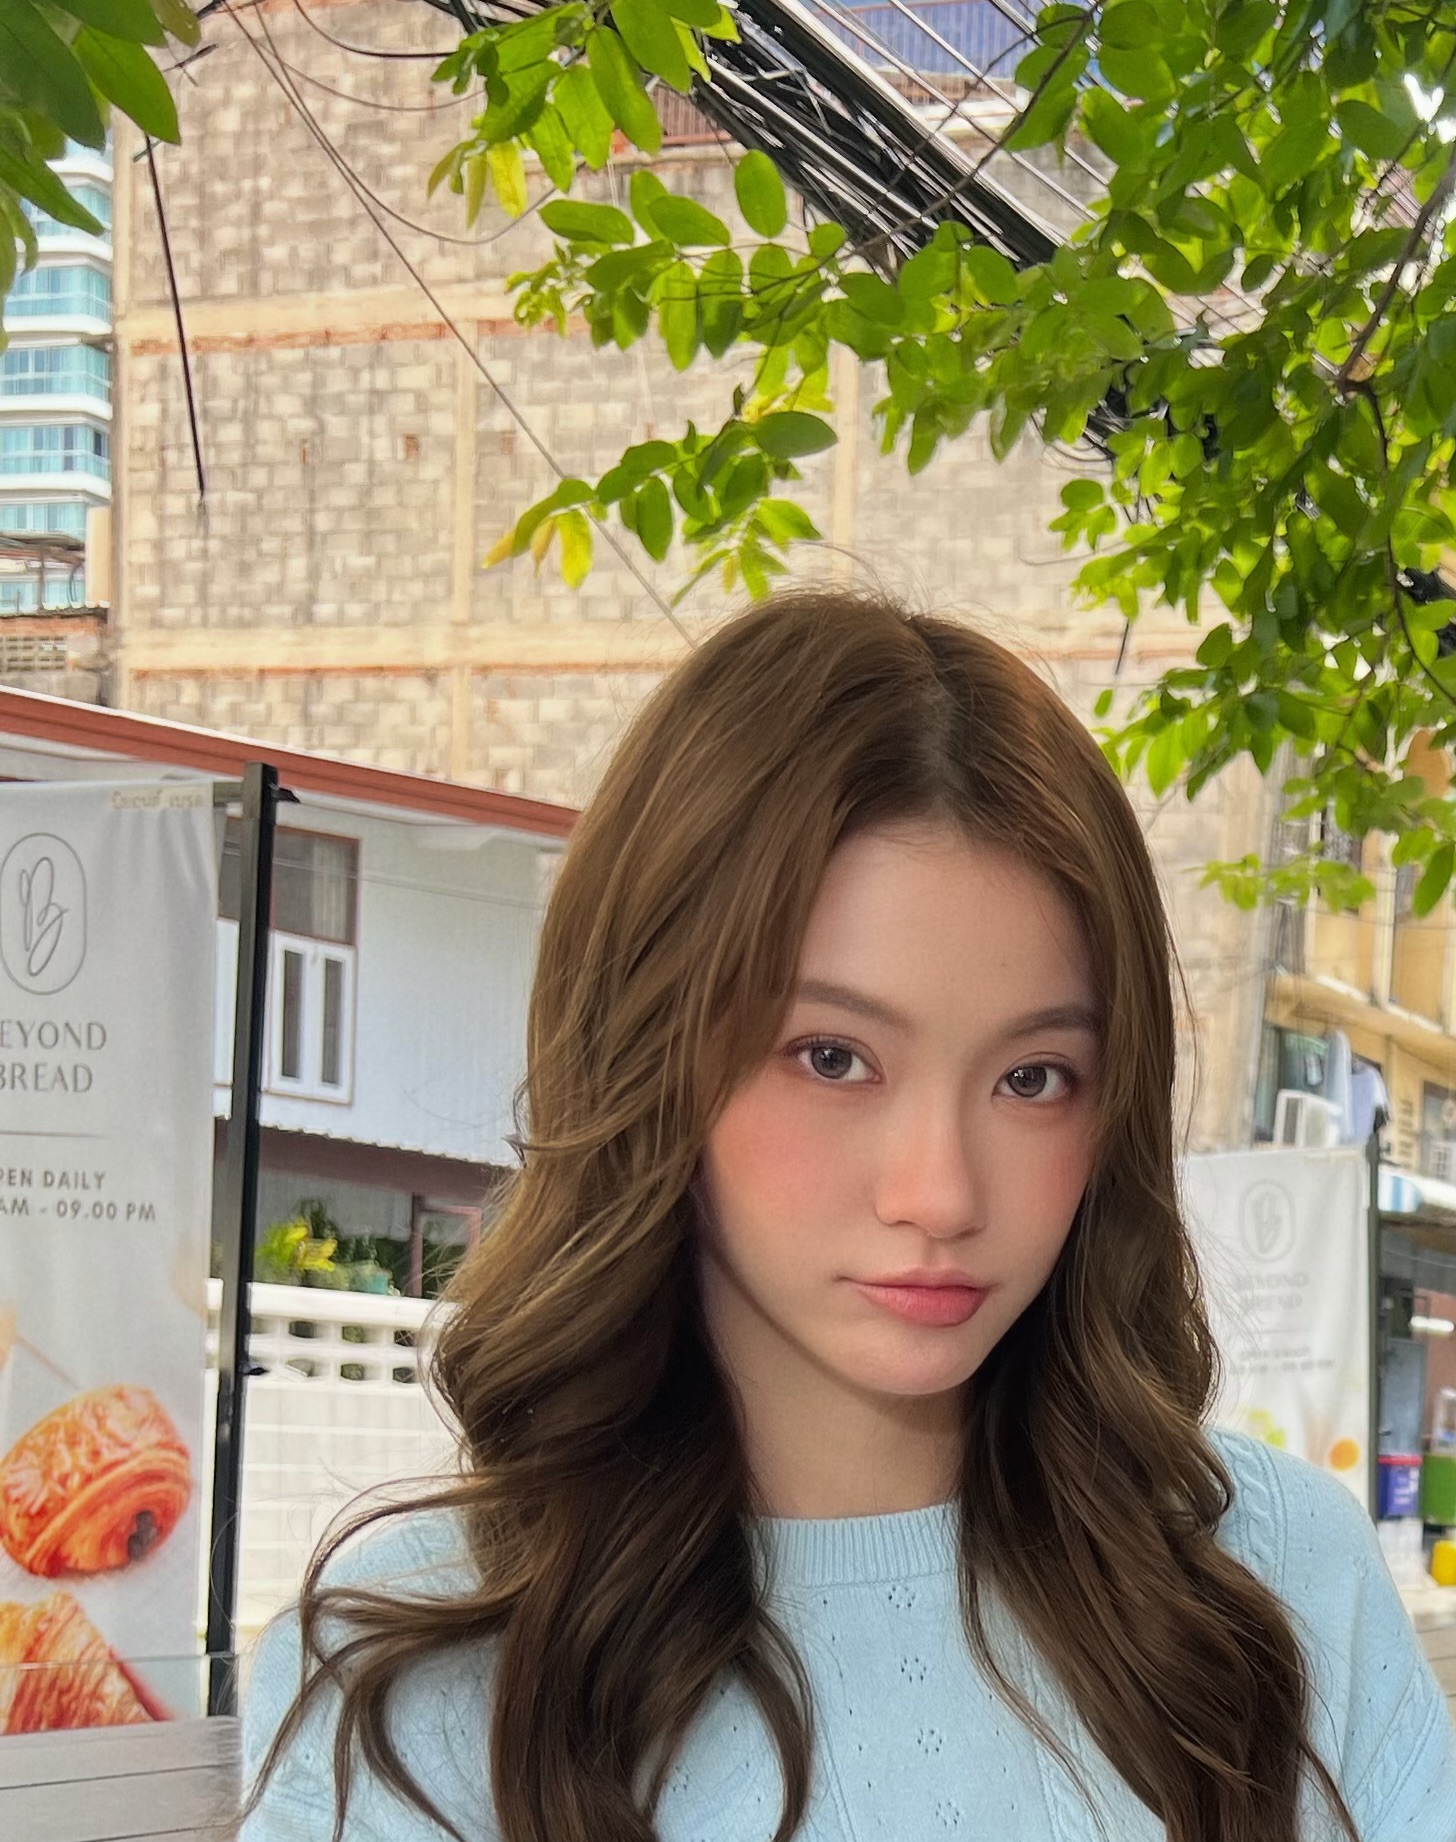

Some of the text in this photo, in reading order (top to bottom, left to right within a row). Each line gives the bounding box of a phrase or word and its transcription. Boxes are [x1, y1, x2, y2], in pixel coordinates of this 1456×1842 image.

[43, 1170, 105, 1190] DAILY
[56, 1200, 118, 1220] 09.00
[126, 1203, 156, 1222] PM
